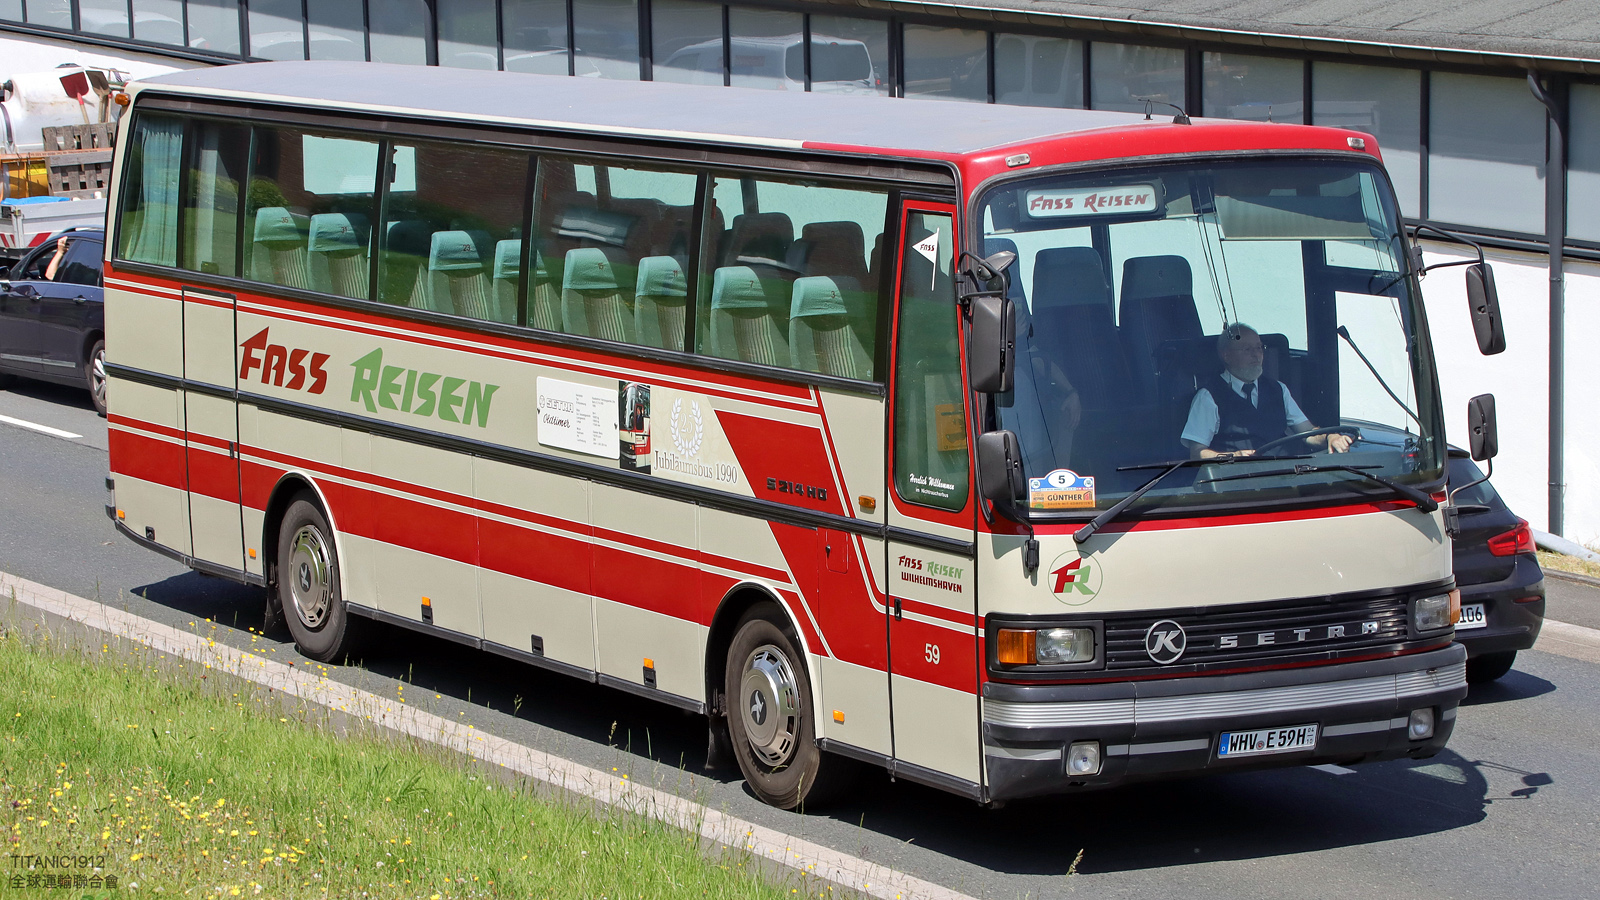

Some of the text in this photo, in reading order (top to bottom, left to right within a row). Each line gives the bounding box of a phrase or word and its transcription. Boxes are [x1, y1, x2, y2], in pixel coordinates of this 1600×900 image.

[1030, 193, 1150, 213] FASS REISEN
[920, 244, 935, 252] FASS
[830, 290, 836, 299] 3
[239, 326, 501, 428] FASS REISEN
[546, 398, 574, 414] SETRA
[543, 413, 571, 429] Oldtimer
[680, 412, 693, 434] 25
[654, 450, 738, 484] Jubiläumsbus 1990
[767, 477, 776, 490] S
[778, 479, 804, 496] 214
[928, 476, 955, 490] Willkommen
[1058, 475, 1066, 484] 5
[1047, 493, 1083, 501] GÜNTHER
[898, 555, 964, 579] FASS REISEN
[1050, 557, 1096, 596] FR
[901, 571, 962, 593] WILHELMSHAVEN
[1460, 606, 1483, 623] 106
[1219, 621, 1378, 649] SETRA
[925, 643, 940, 665] 59
[1229, 733, 1258, 751] WHV
[1266, 731, 1276, 749] E
[1277, 728, 1307, 747] 59H
